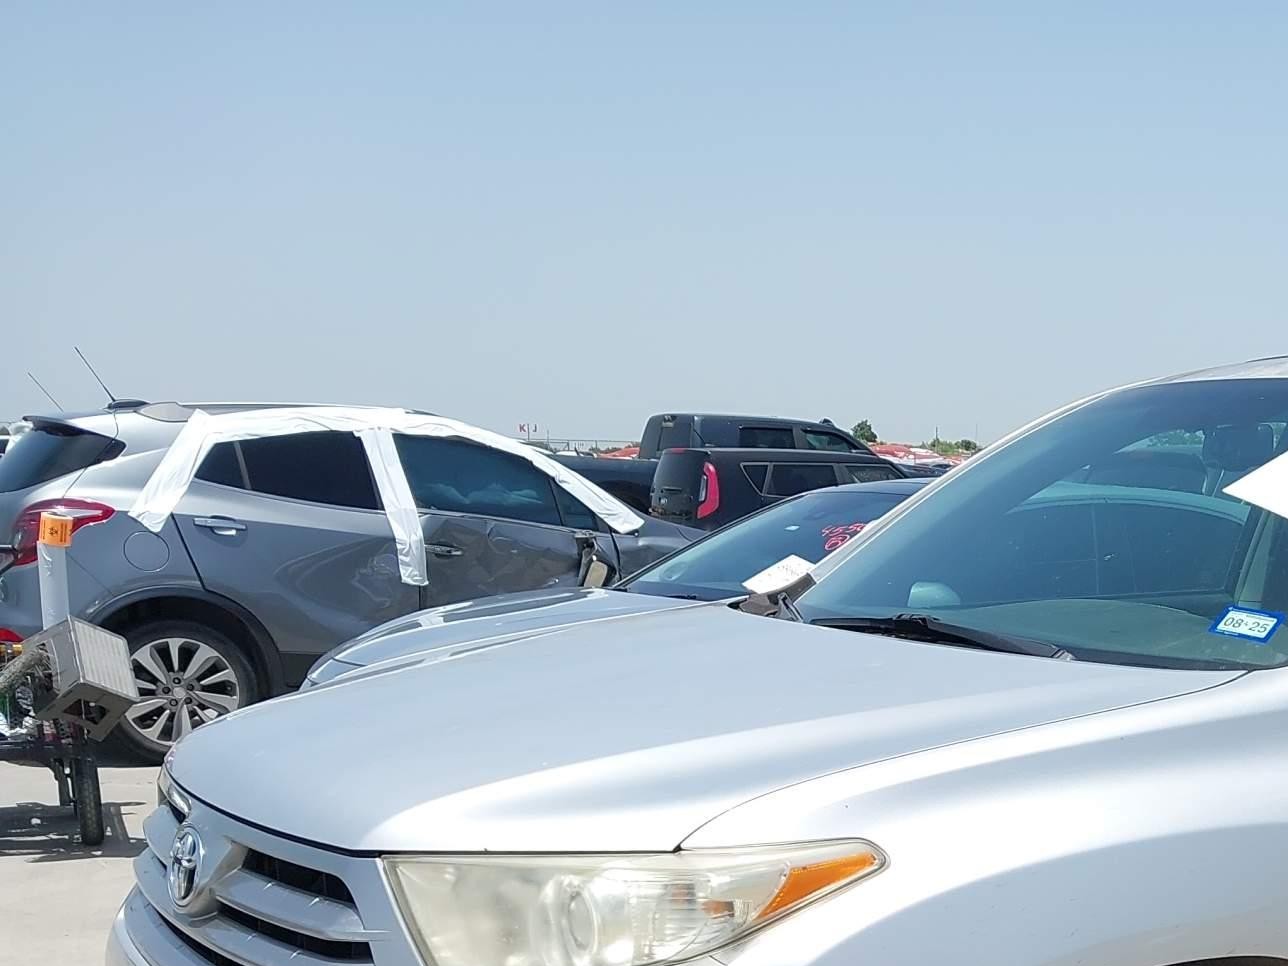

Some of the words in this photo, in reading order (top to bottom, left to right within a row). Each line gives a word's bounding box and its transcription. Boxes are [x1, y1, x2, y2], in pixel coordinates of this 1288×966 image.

[518, 423, 527, 433] K
[1223, 616, 1244, 628] 08
[1248, 621, 1270, 633] 25
